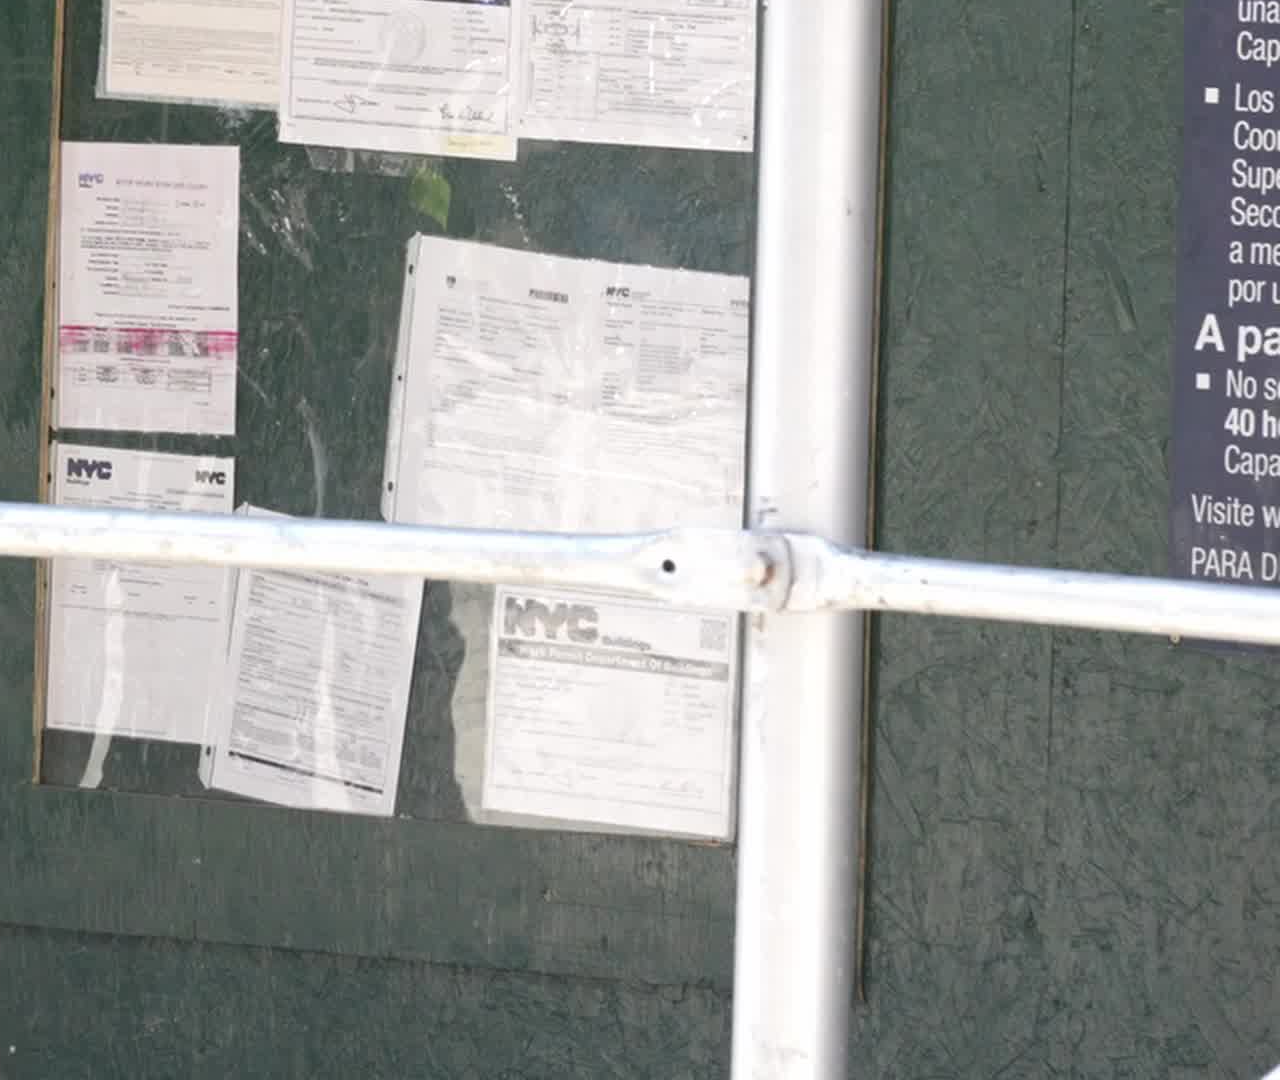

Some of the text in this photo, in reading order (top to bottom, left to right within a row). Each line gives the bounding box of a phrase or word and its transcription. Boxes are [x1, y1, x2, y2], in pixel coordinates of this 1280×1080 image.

[1235, 83, 1273, 113] Los
[1229, 242, 1243, 263] a
[1228, 279, 1266, 307] por
[1195, 314, 1225, 352] A
[1226, 369, 1257, 399] No
[1224, 408, 1255, 437] 40
[66, 457, 112, 480] NYC
[195, 470, 226, 485] NYC
[1191, 493, 1254, 527] Visite
[1191, 547, 1253, 579] PARA
[504, 596, 599, 643] NYC
